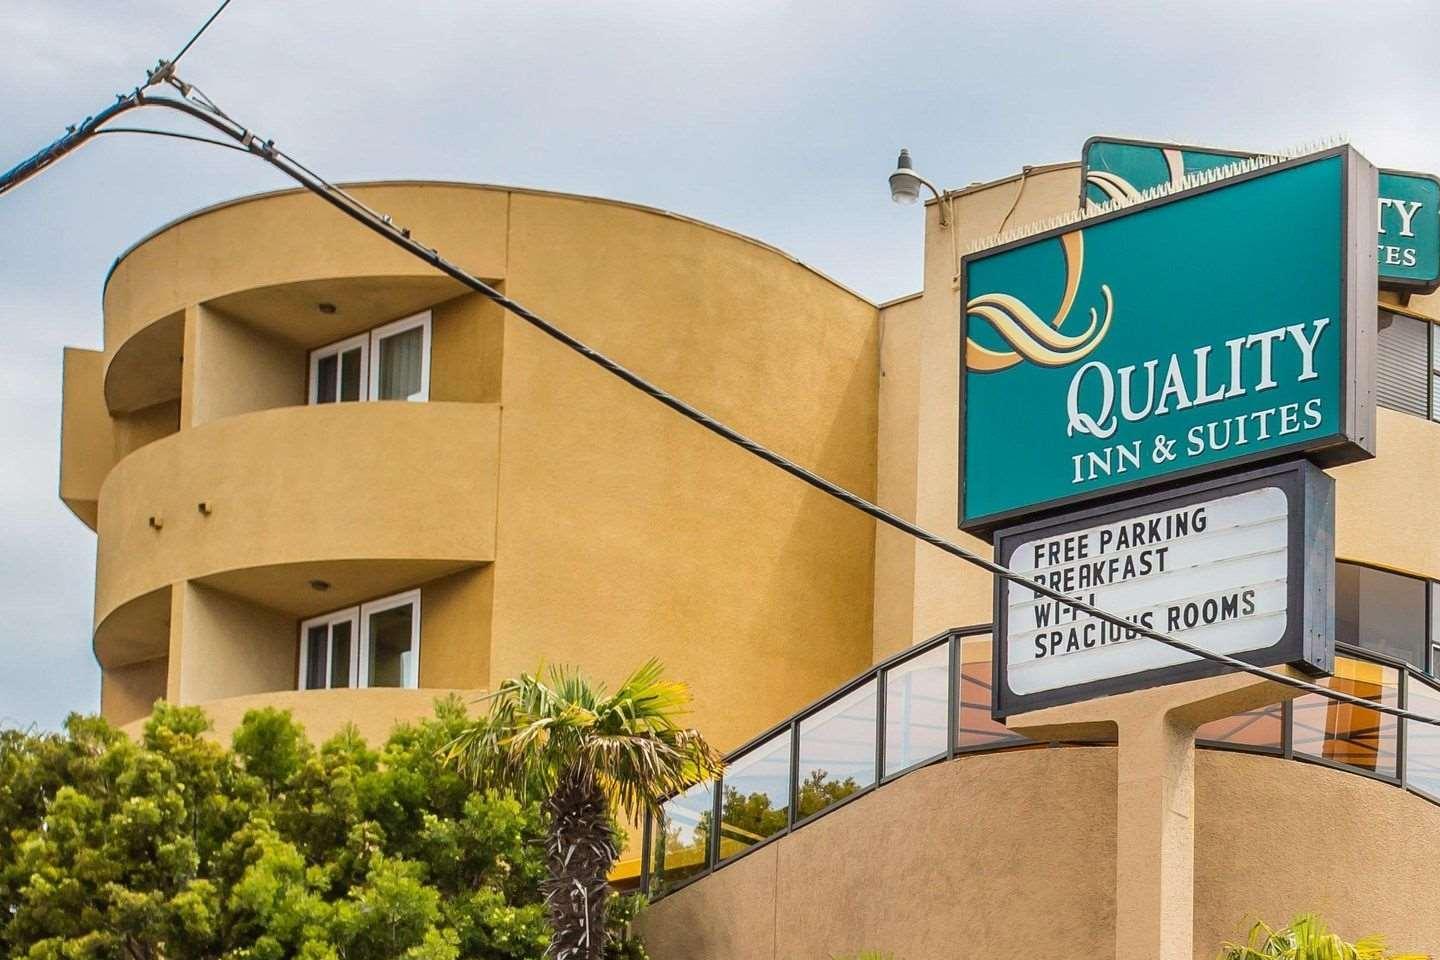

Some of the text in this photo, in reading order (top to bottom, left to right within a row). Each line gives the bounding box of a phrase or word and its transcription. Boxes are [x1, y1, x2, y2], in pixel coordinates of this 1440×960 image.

[1066, 317, 1329, 439] QUALITY
[1072, 397, 1323, 484] INN & SUITES
[1034, 507, 1207, 568] FREE PARKING
[1033, 546, 1169, 600] BREAKFAST
[1034, 593, 1096, 628] WI-FI
[1034, 590, 1255, 658] SPACIOUS ROOMS
